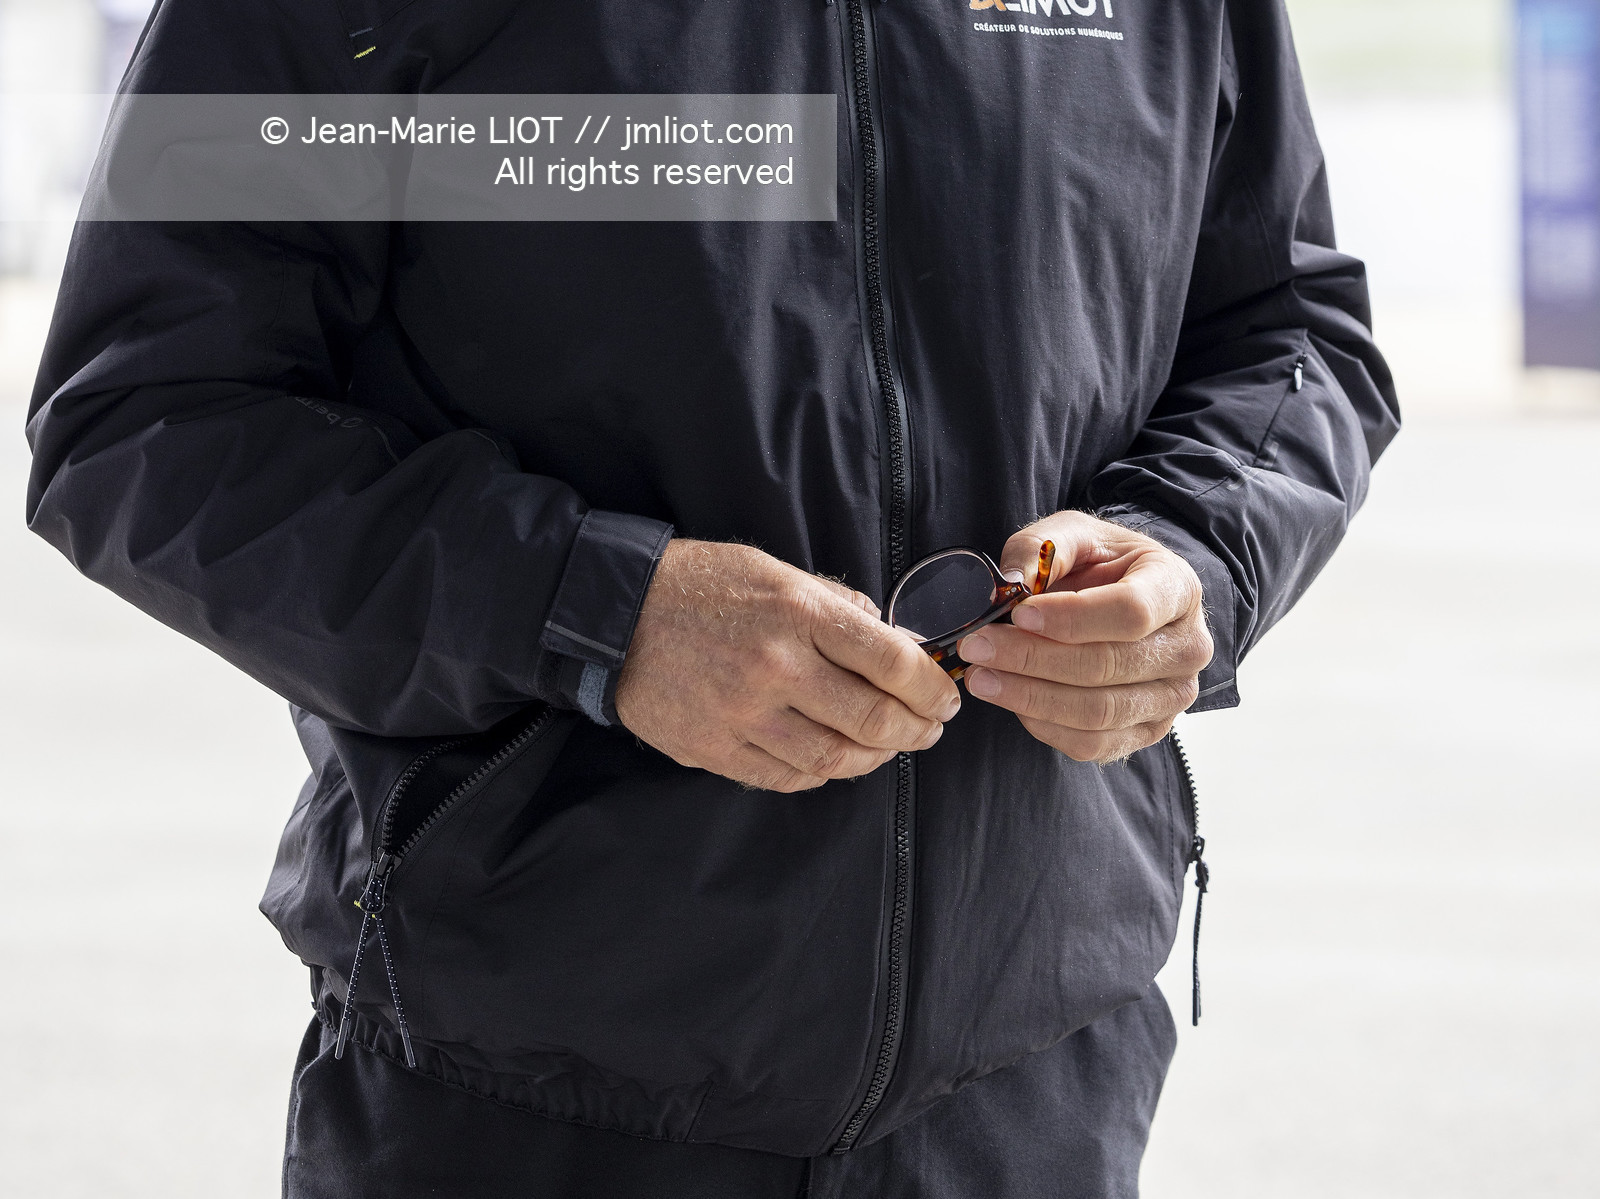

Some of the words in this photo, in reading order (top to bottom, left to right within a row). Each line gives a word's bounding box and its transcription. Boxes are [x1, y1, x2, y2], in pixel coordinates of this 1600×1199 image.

[973, 22, 1017, 33] CRÉATEUR
[1018, 23, 1030, 34] DE
[1029, 25, 1077, 37] SOLUTIONS
[1077, 27, 1124, 41] NUMÉRIQUES
